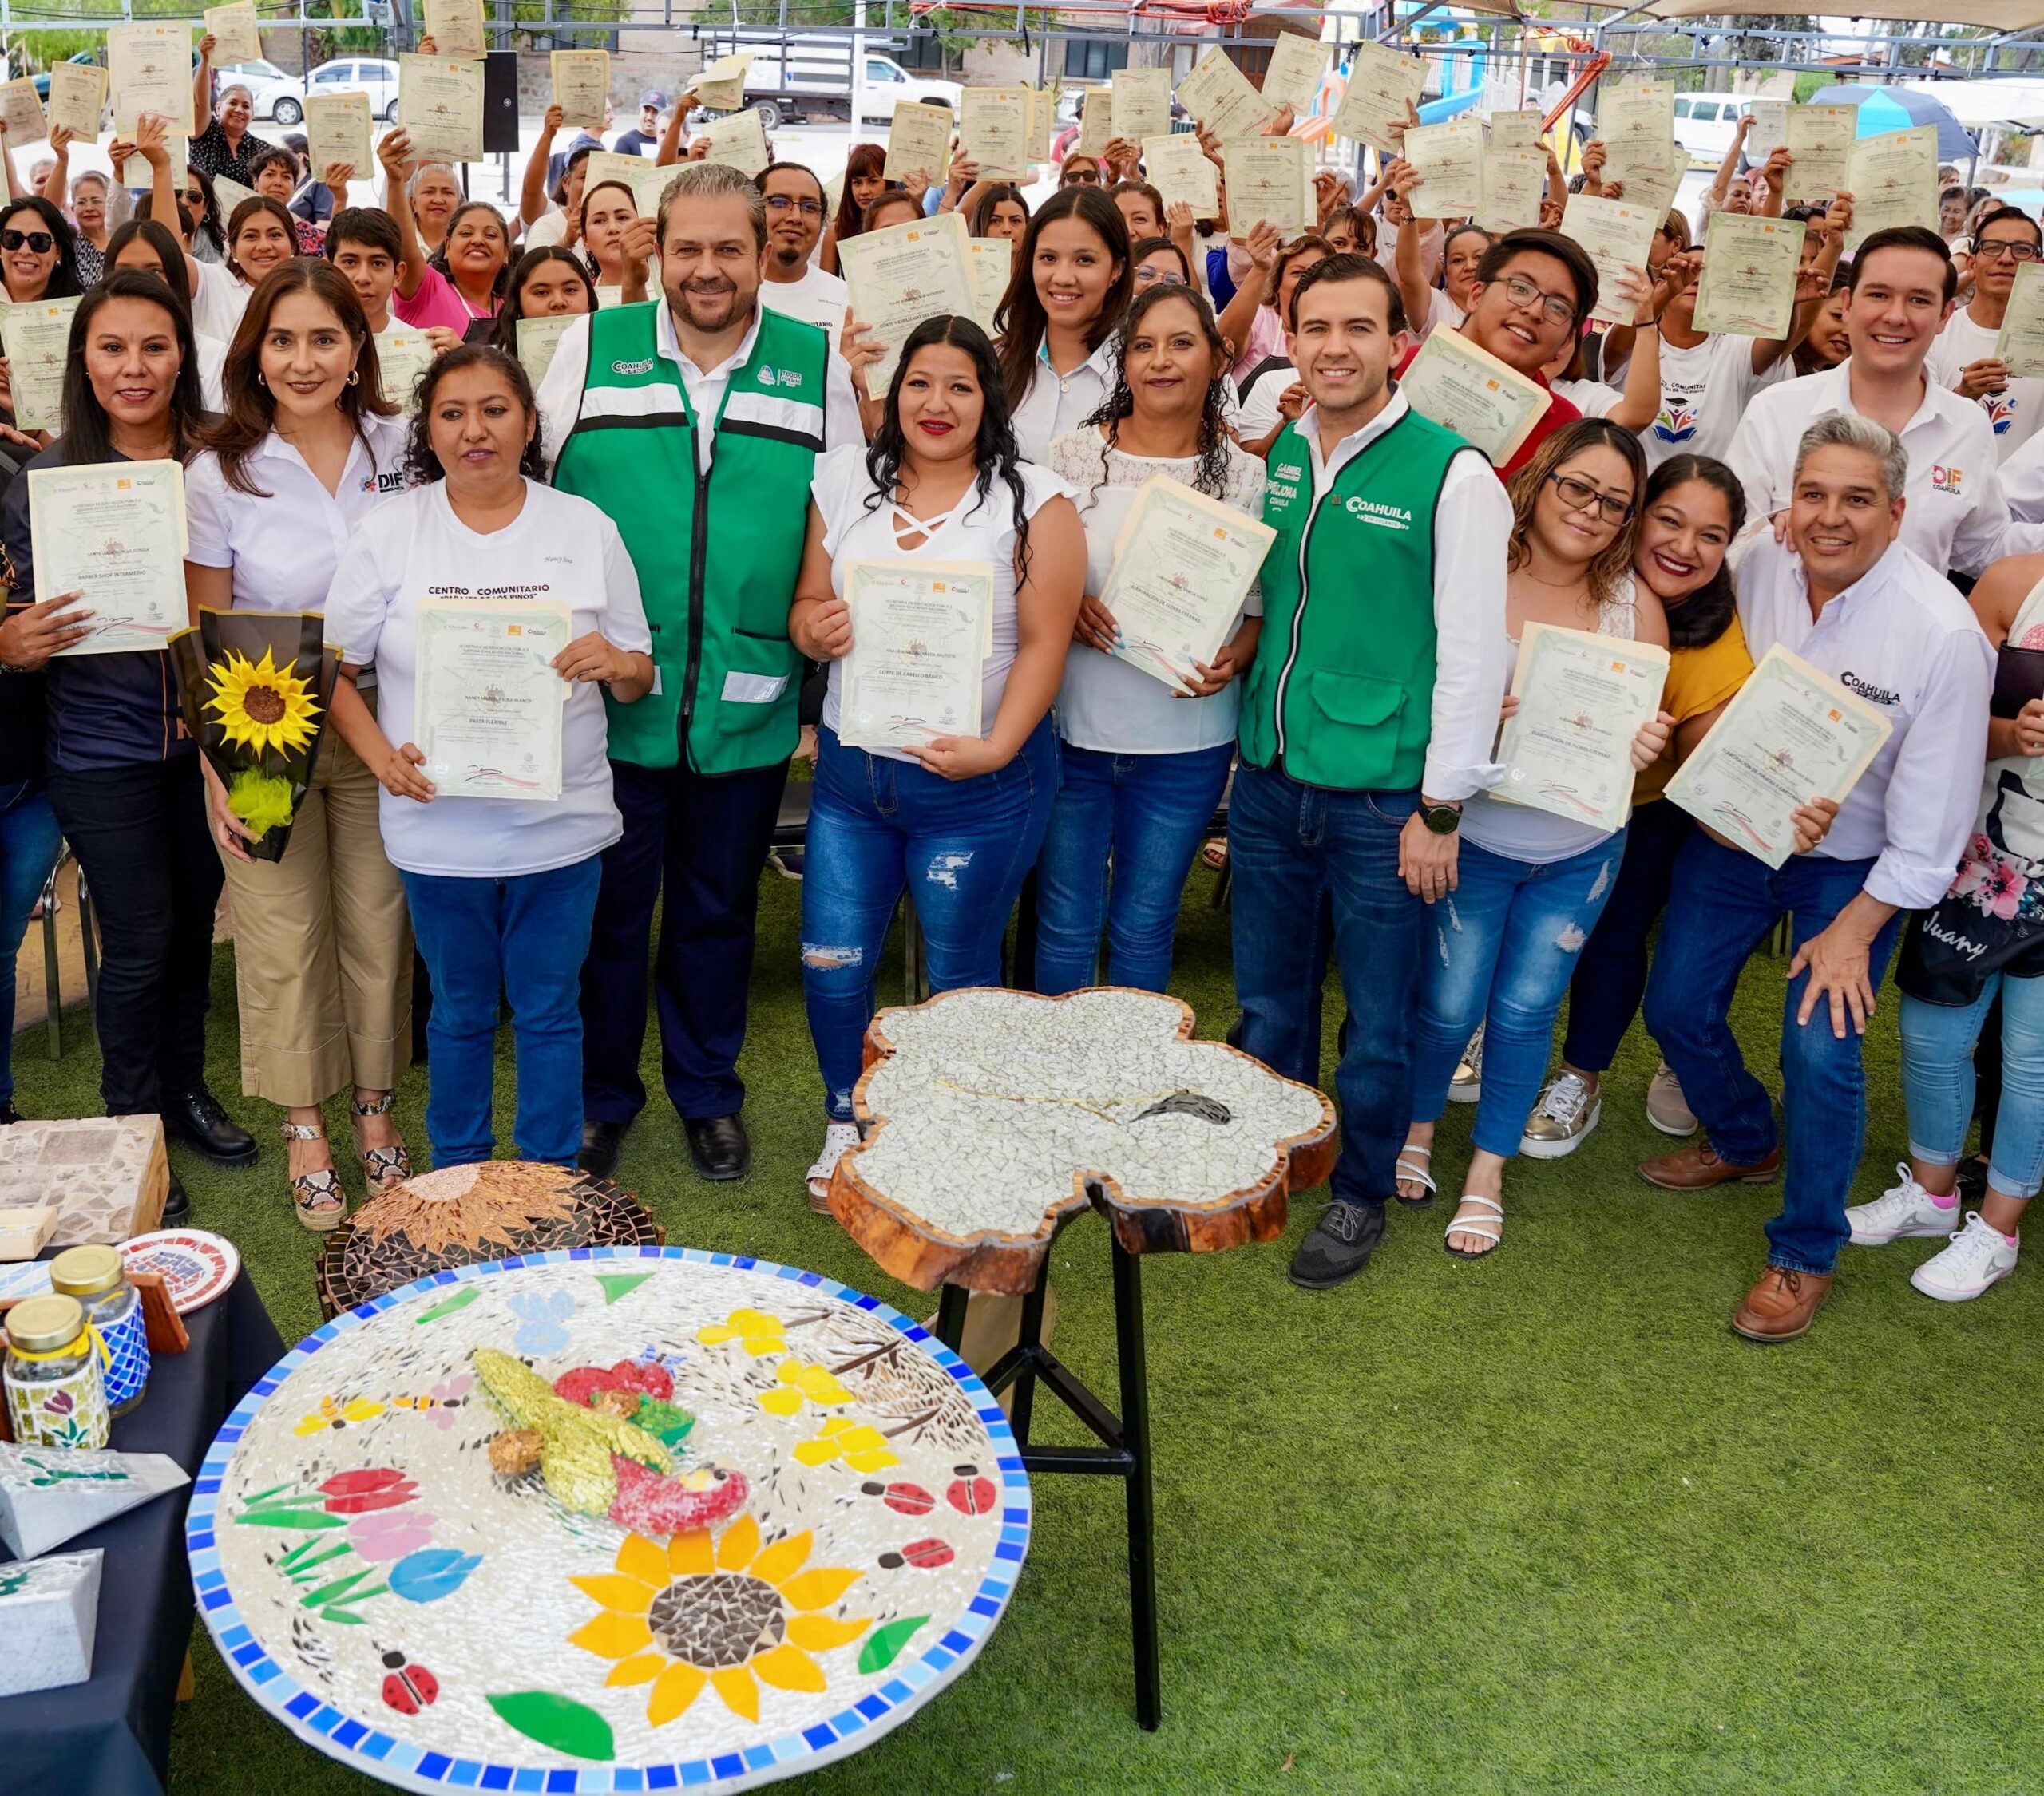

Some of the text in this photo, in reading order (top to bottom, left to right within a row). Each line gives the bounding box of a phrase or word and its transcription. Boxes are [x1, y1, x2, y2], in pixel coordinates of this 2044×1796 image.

[612, 358, 653, 372] COAHUILA
[782, 370, 801, 379] TODOS
[378, 473, 403, 489] DIF
[1932, 465, 1963, 489] DIF
[1933, 485, 1961, 495] COAHUILA
[1345, 496, 1412, 521] COAHUILA
[477, 584, 550, 595] COMUNITARIO
[1840, 671, 1900, 702] COAHUILA
[1922, 910, 1987, 962] Juany
